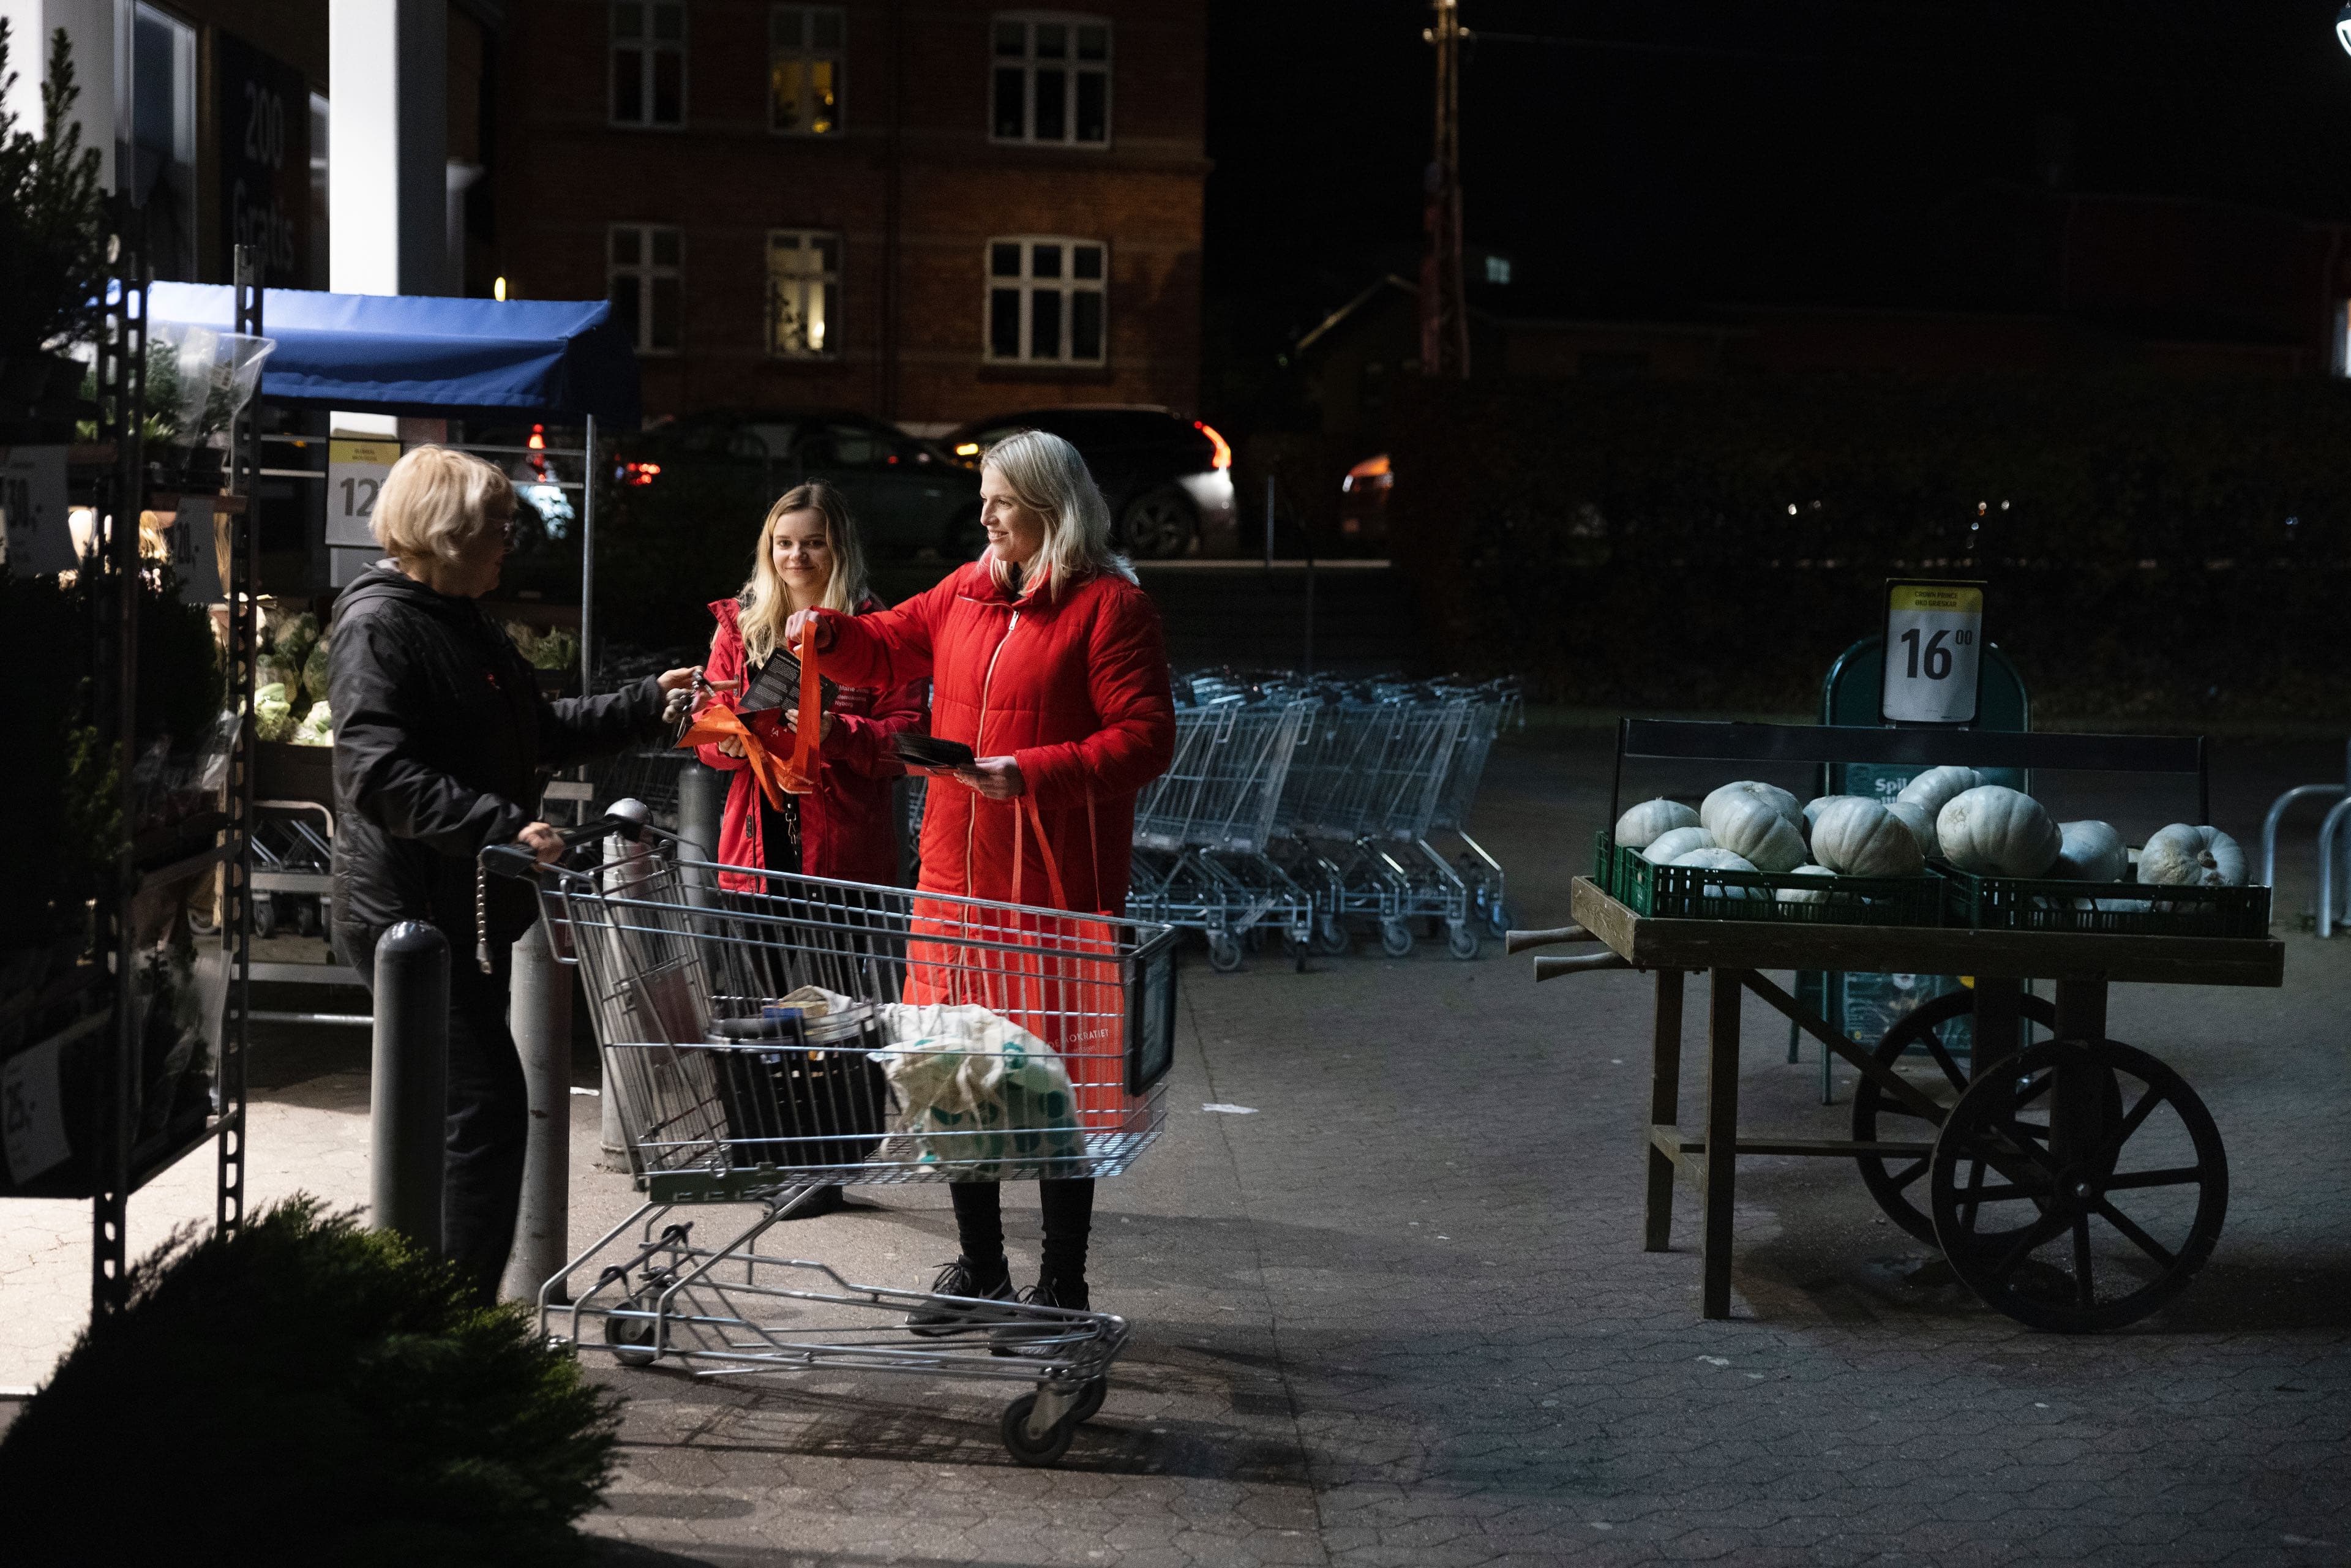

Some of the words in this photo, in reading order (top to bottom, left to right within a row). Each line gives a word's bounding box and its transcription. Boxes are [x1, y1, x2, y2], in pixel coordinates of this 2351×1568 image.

[340, 478, 378, 517] 12
[1901, 628, 1952, 680] 16
[1955, 629, 1973, 645] 00
